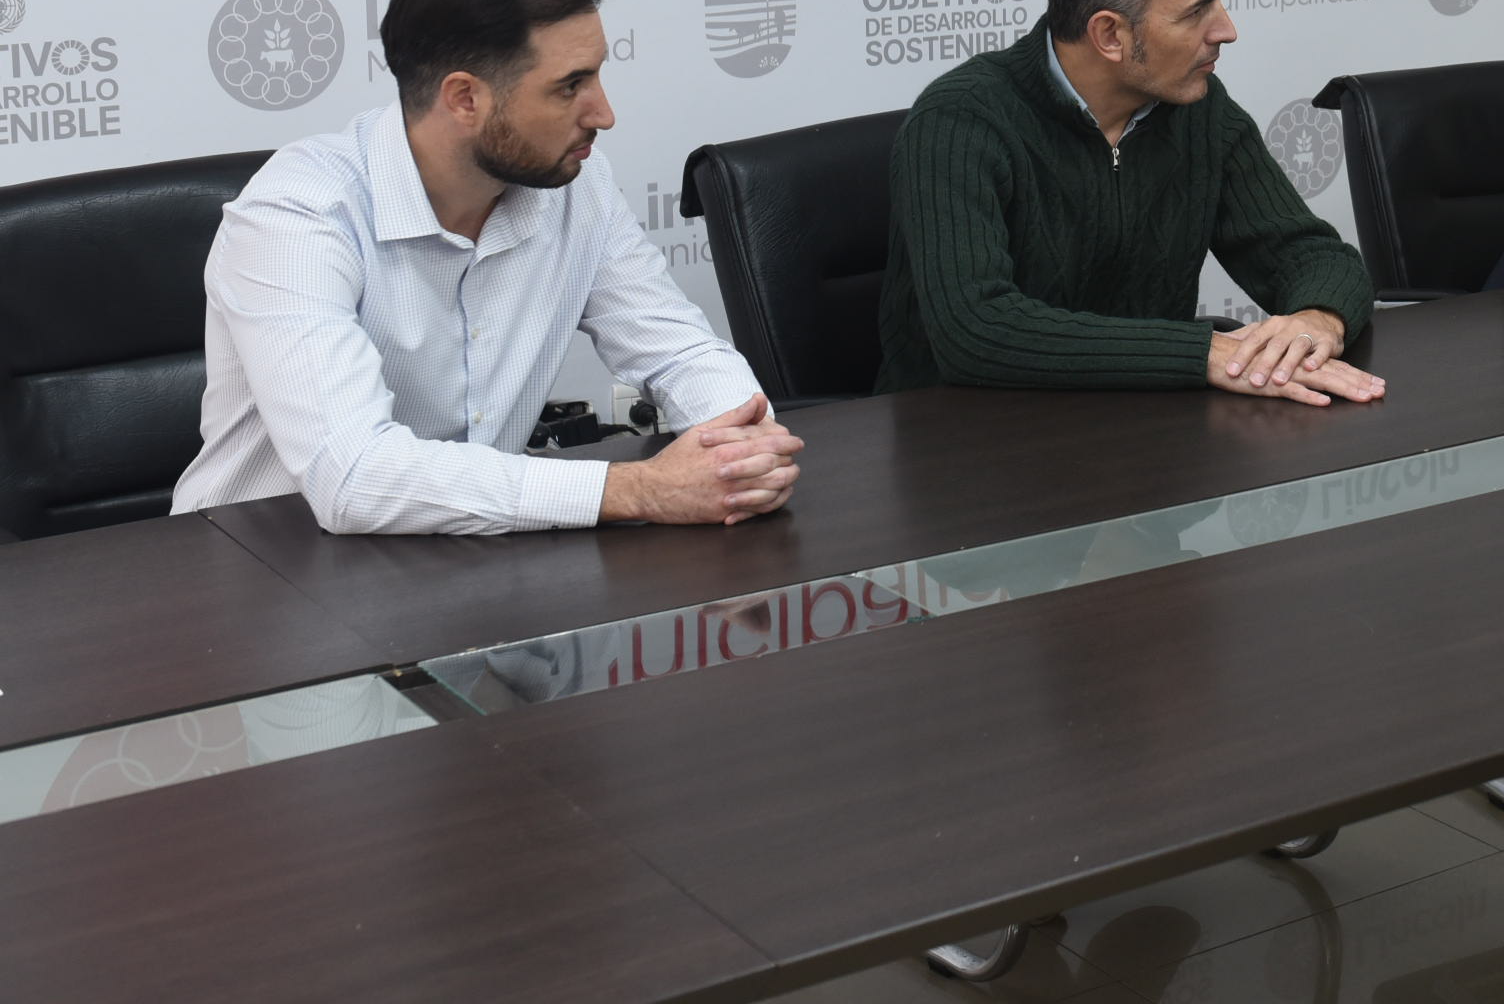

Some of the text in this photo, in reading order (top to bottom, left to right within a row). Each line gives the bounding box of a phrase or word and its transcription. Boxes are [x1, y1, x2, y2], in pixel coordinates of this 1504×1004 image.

[865, 7, 1027, 37] DE DESARROLLO
[0, 78, 119, 110] RROLLO
